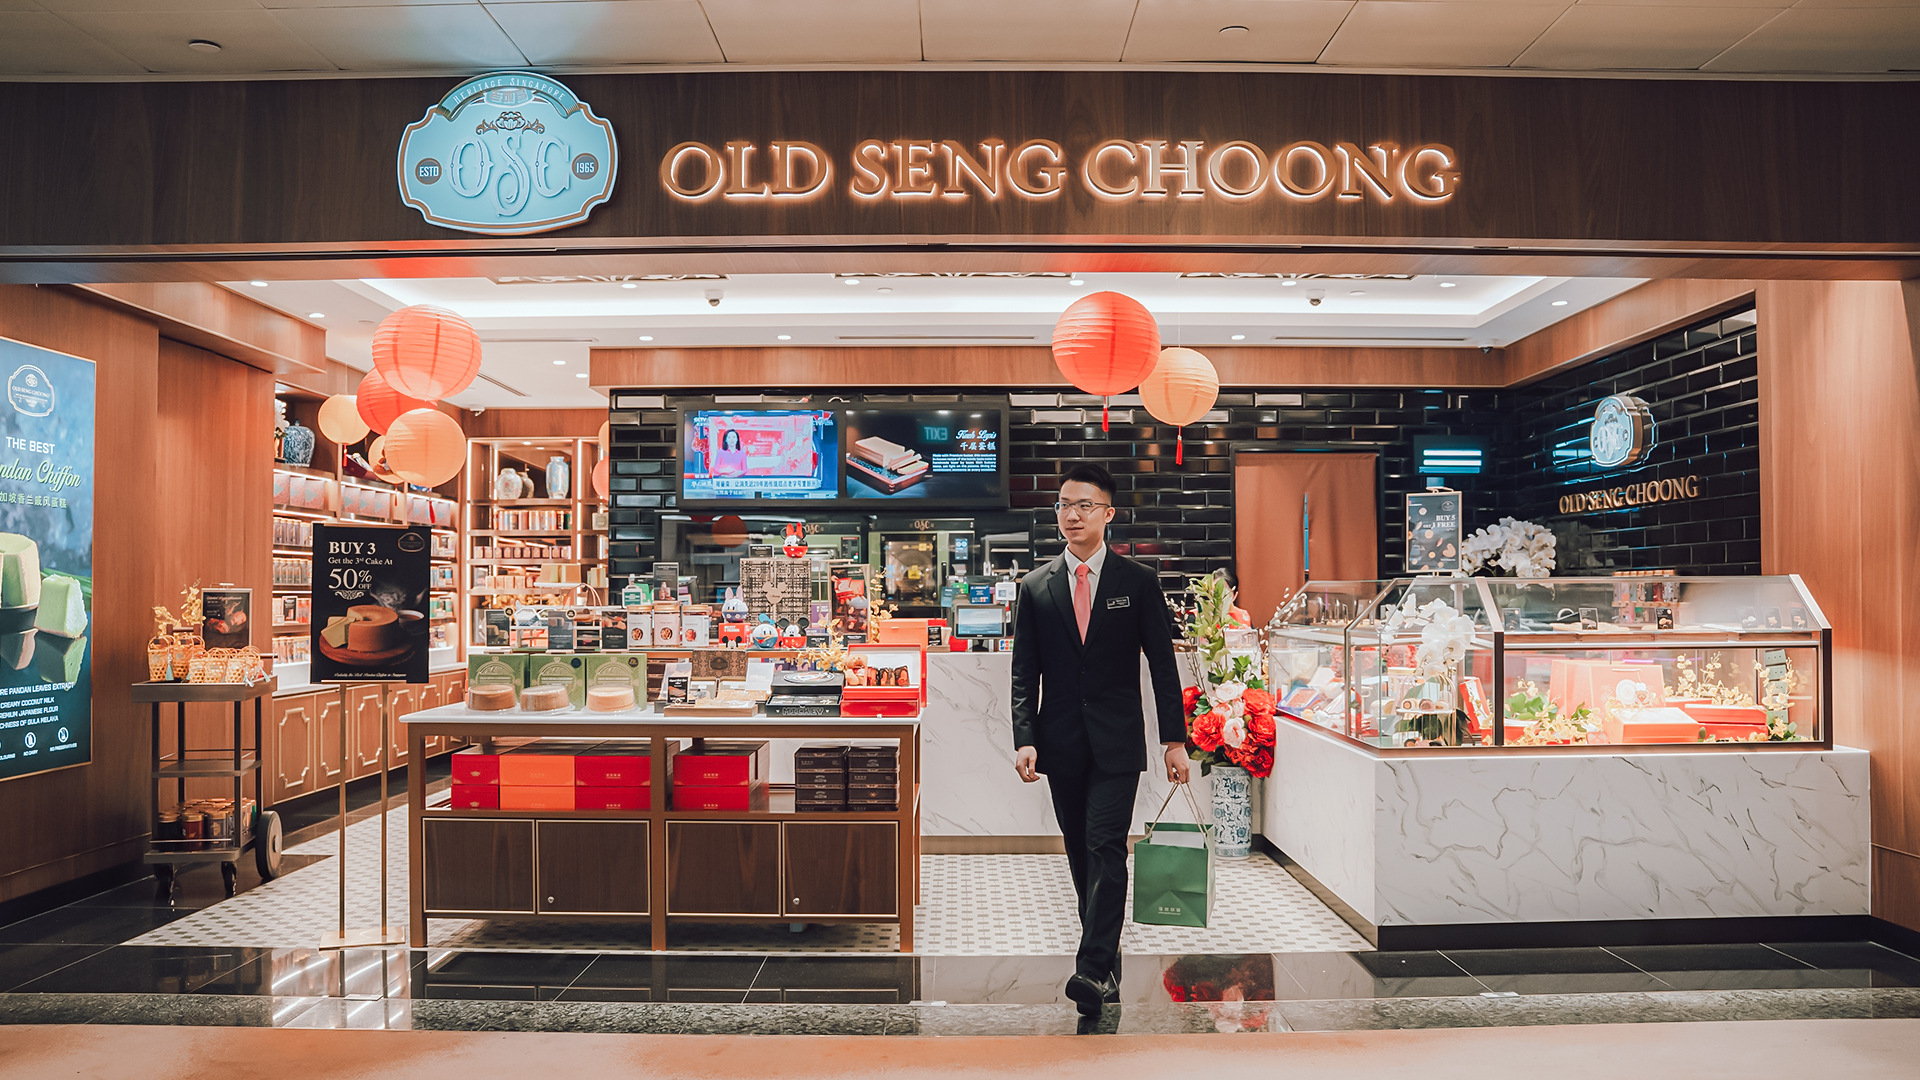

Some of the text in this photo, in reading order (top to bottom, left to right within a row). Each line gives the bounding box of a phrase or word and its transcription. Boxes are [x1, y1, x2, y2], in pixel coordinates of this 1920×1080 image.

[453, 79, 502, 104] HERITAGE
[510, 78, 566, 101] SINGAPORE
[419, 166, 439, 178] ESTD
[575, 162, 595, 174] 1965
[661, 138, 1462, 200] OLD SENG CHOONG
[449, 134, 570, 217] OSC
[6, 436, 55, 455] THE BEST
[37, 460, 81, 492] Chiffon
[1559, 475, 1699, 514] OLD SENG CHOONG
[328, 541, 376, 555] BUY 3
[328, 557, 341, 565] Get
[343, 557, 353, 565] the
[365, 558, 382, 566] Cake
[384, 558, 393, 566] At
[328, 568, 372, 589] 50%
[9, 686, 31, 695] PANDAN
[32, 684, 51, 692] LEAVES
[52, 682, 75, 690] EXTRACT
[21, 698, 43, 706] COCONUT
[19, 708, 43, 716] JAPANESE
[44, 705, 59, 713] FLOUR
[782, 707, 824, 715] MICKEY
[41, 715, 59, 723] MELAKA
